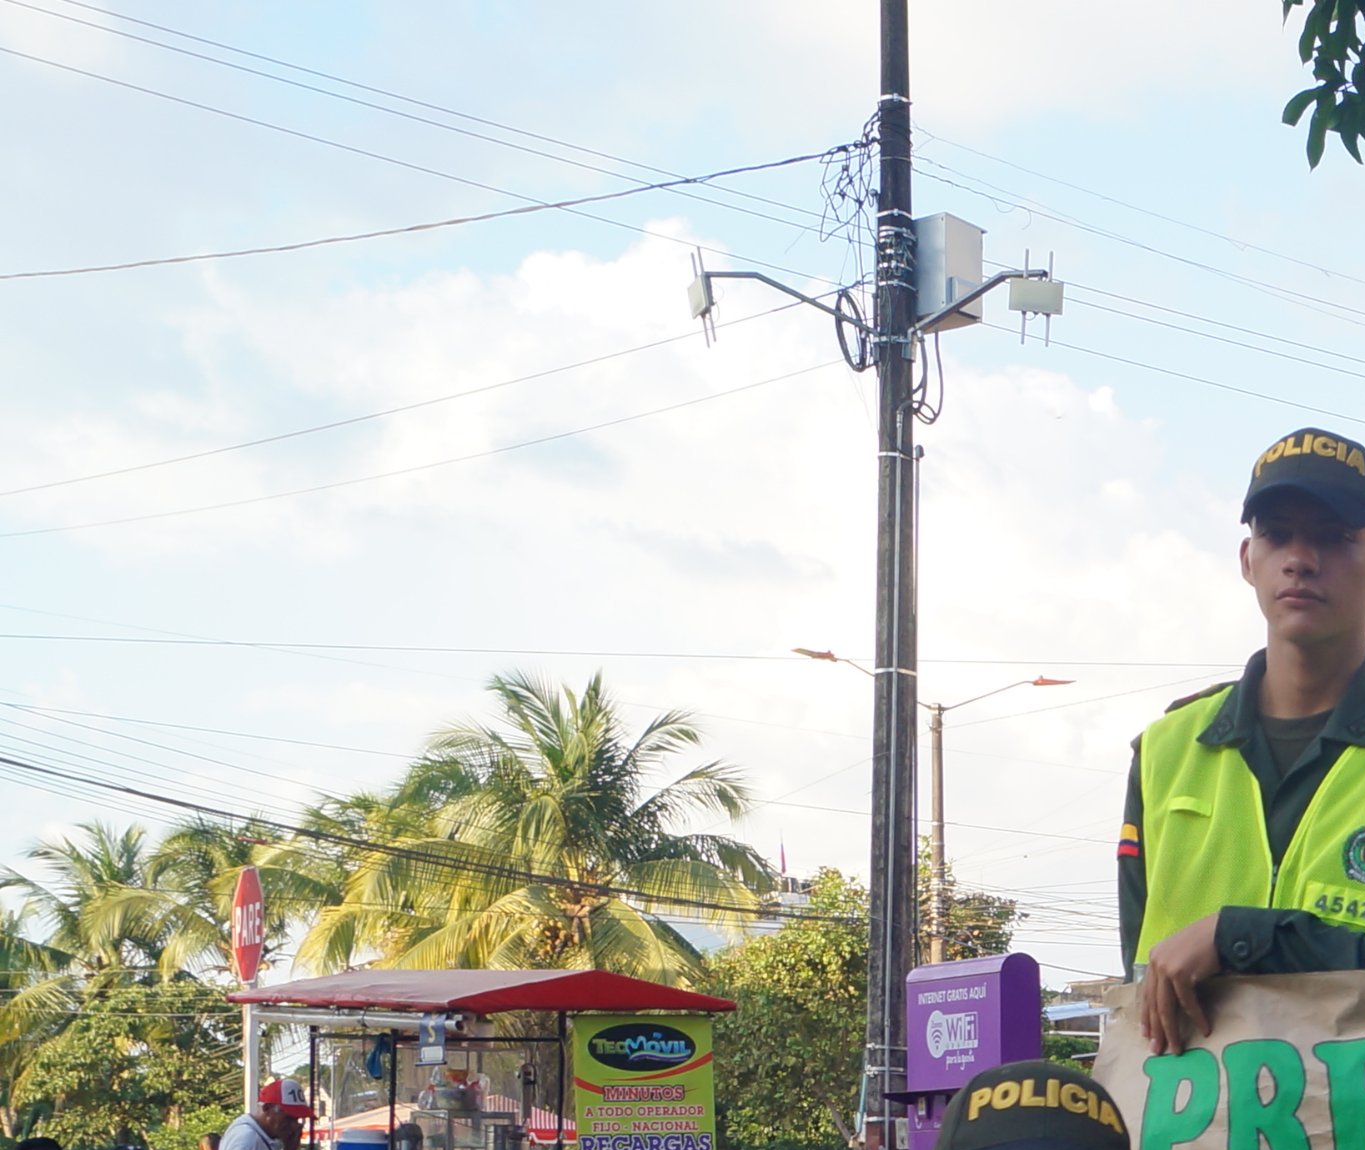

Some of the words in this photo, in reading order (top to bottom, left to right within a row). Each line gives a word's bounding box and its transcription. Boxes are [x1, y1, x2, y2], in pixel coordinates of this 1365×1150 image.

[234, 903, 261, 947] PARE
[918, 987, 946, 1005] INTERNET
[947, 987, 969, 1001] GRATIS
[604, 1086, 684, 1102] MINUTOS
[586, 1107, 594, 1118] A
[598, 1106, 634, 1117] TODO
[637, 1105, 705, 1117] OPERADOR
[968, 1078, 1124, 1134] POLICIA
[592, 1122, 621, 1132] FIJO
[632, 1120, 699, 1132] NACIONAL
